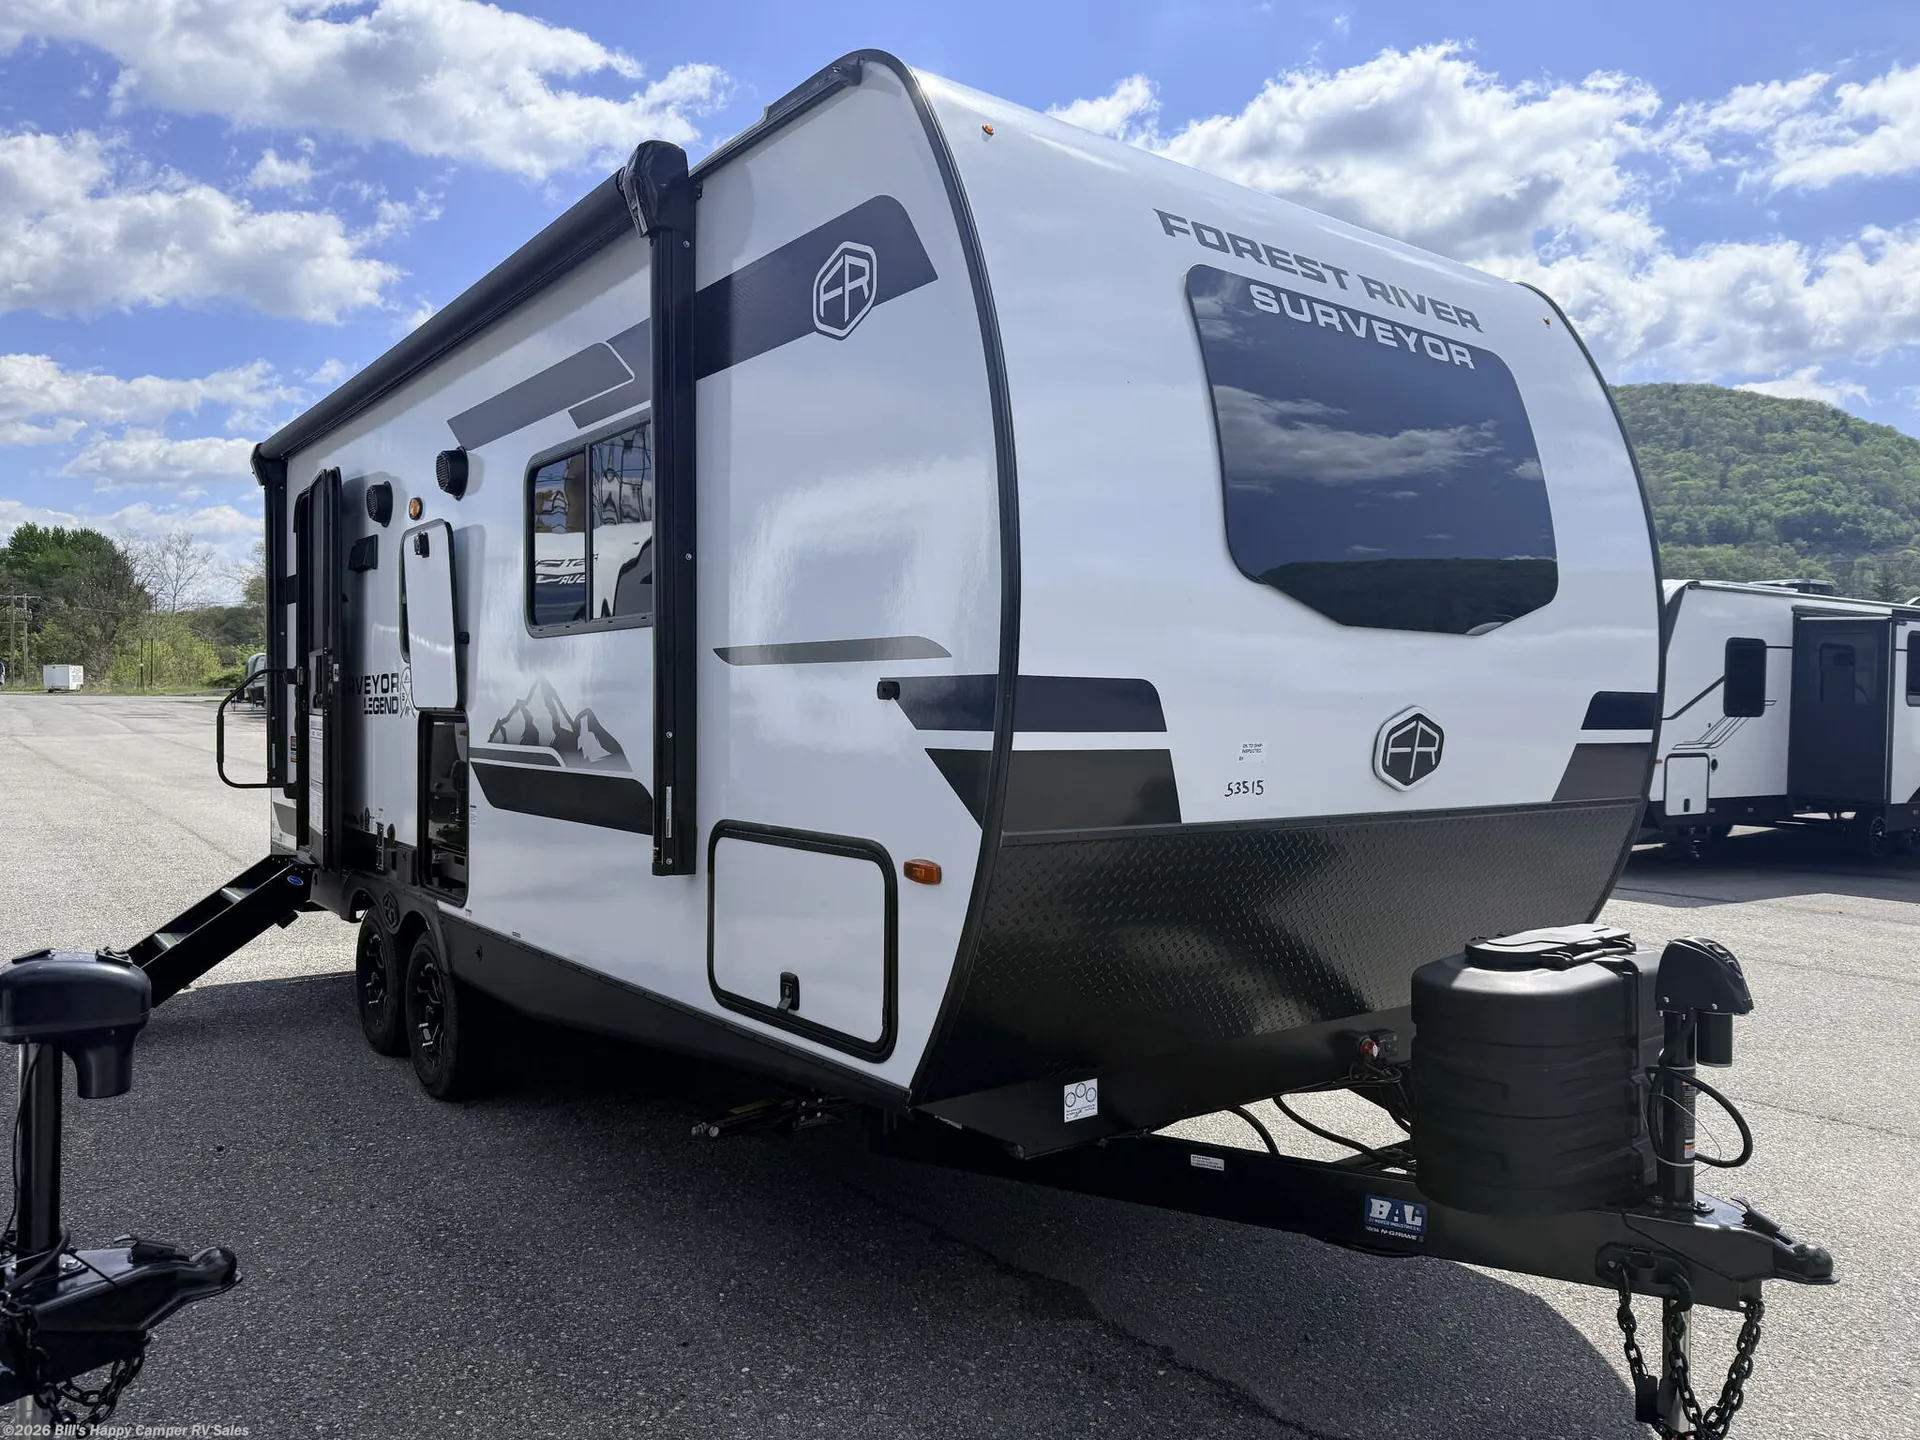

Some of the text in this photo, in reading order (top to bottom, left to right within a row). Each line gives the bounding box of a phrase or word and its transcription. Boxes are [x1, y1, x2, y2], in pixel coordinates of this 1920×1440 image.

[1152, 208, 1485, 334] FOREST RIVER
[1249, 284, 1476, 370] SURVEYOR
[363, 696, 399, 715] LEGEND
[1224, 780, 1264, 797] 53515
[1370, 1198, 1423, 1226] BAL
